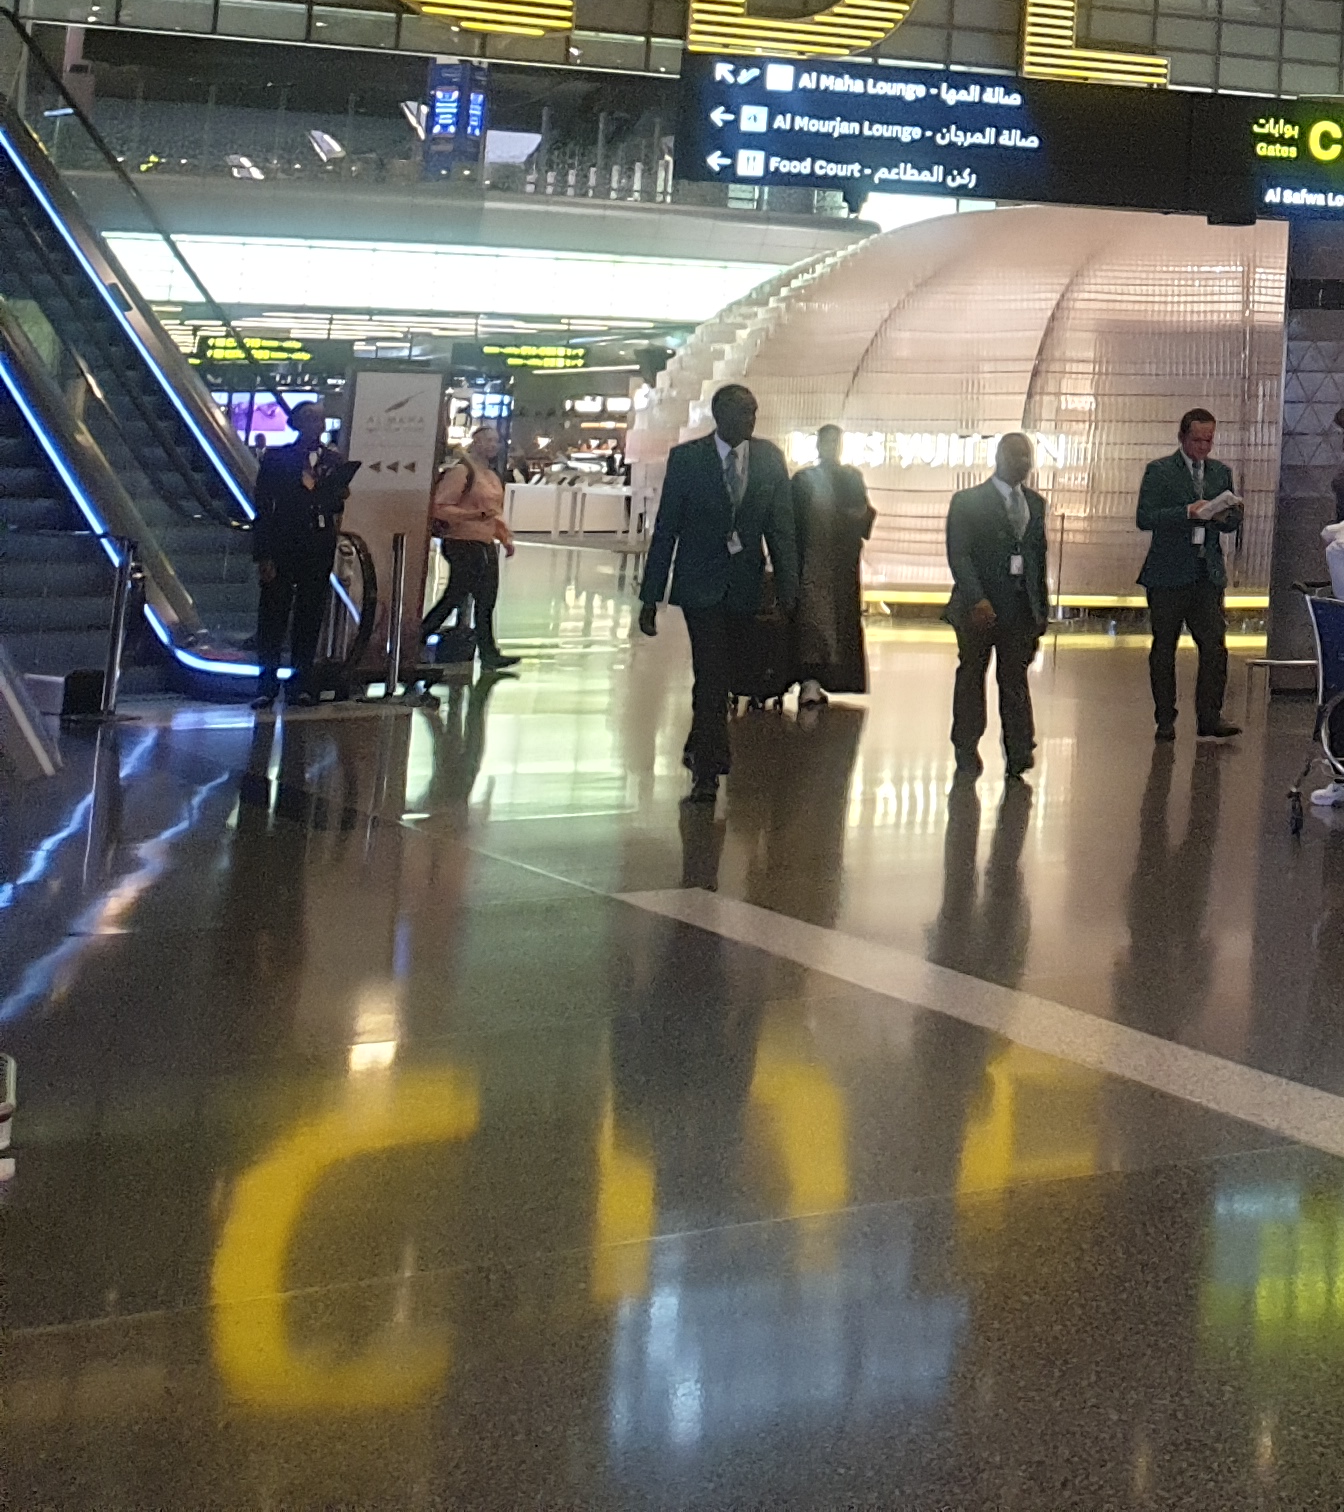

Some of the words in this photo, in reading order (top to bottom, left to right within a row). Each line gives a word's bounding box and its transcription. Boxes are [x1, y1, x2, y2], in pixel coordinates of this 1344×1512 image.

[798, 71, 817, 89] Al
[819, 74, 865, 94] Maha
[866, 78, 926, 101] Lounge
[940, 82, 980, 106] المها
[982, 86, 1022, 106] صالة
[773, 113, 791, 131] Al
[794, 115, 860, 138] Mourjan
[863, 120, 922, 142] Lounge
[935, 124, 995, 147] المرجان
[998, 128, 1040, 148] صالة
[1252, 117, 1300, 139] بوابات
[1256, 142, 1298, 159] Gates
[769, 156, 811, 175] Food
[813, 159, 862, 178] Court
[873, 162, 944, 184] المطاعم
[947, 166, 977, 188] ركن
[1264, 187, 1281, 204] Al
[1282, 188, 1326, 207] Safwa
[895, 431, 1066, 469] VUITTN
